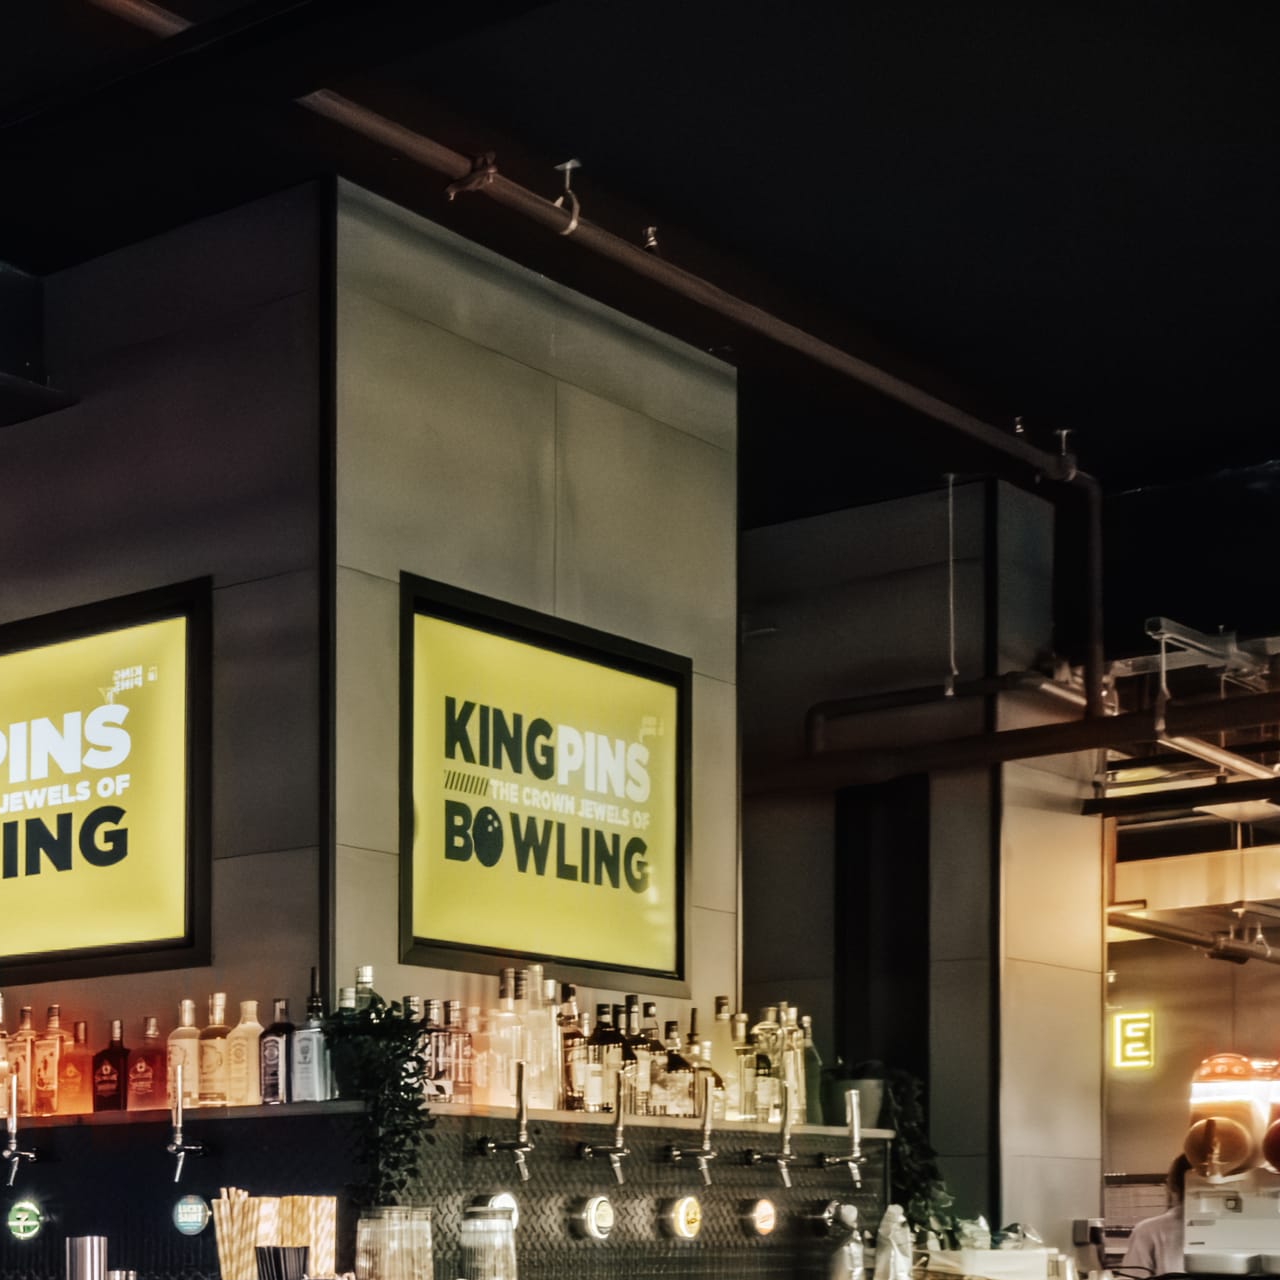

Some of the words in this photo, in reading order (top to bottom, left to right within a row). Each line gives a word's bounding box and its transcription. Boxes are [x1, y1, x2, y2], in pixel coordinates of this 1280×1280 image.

[445, 695, 651, 804] KINGPINS
[96, 774, 131, 798] OF
[490, 779, 519, 804] THE
[522, 786, 575, 816] CROWN
[578, 799, 629, 827] JEWELS
[632, 812, 650, 829] OF
[444, 799, 649, 894] BOWLING
